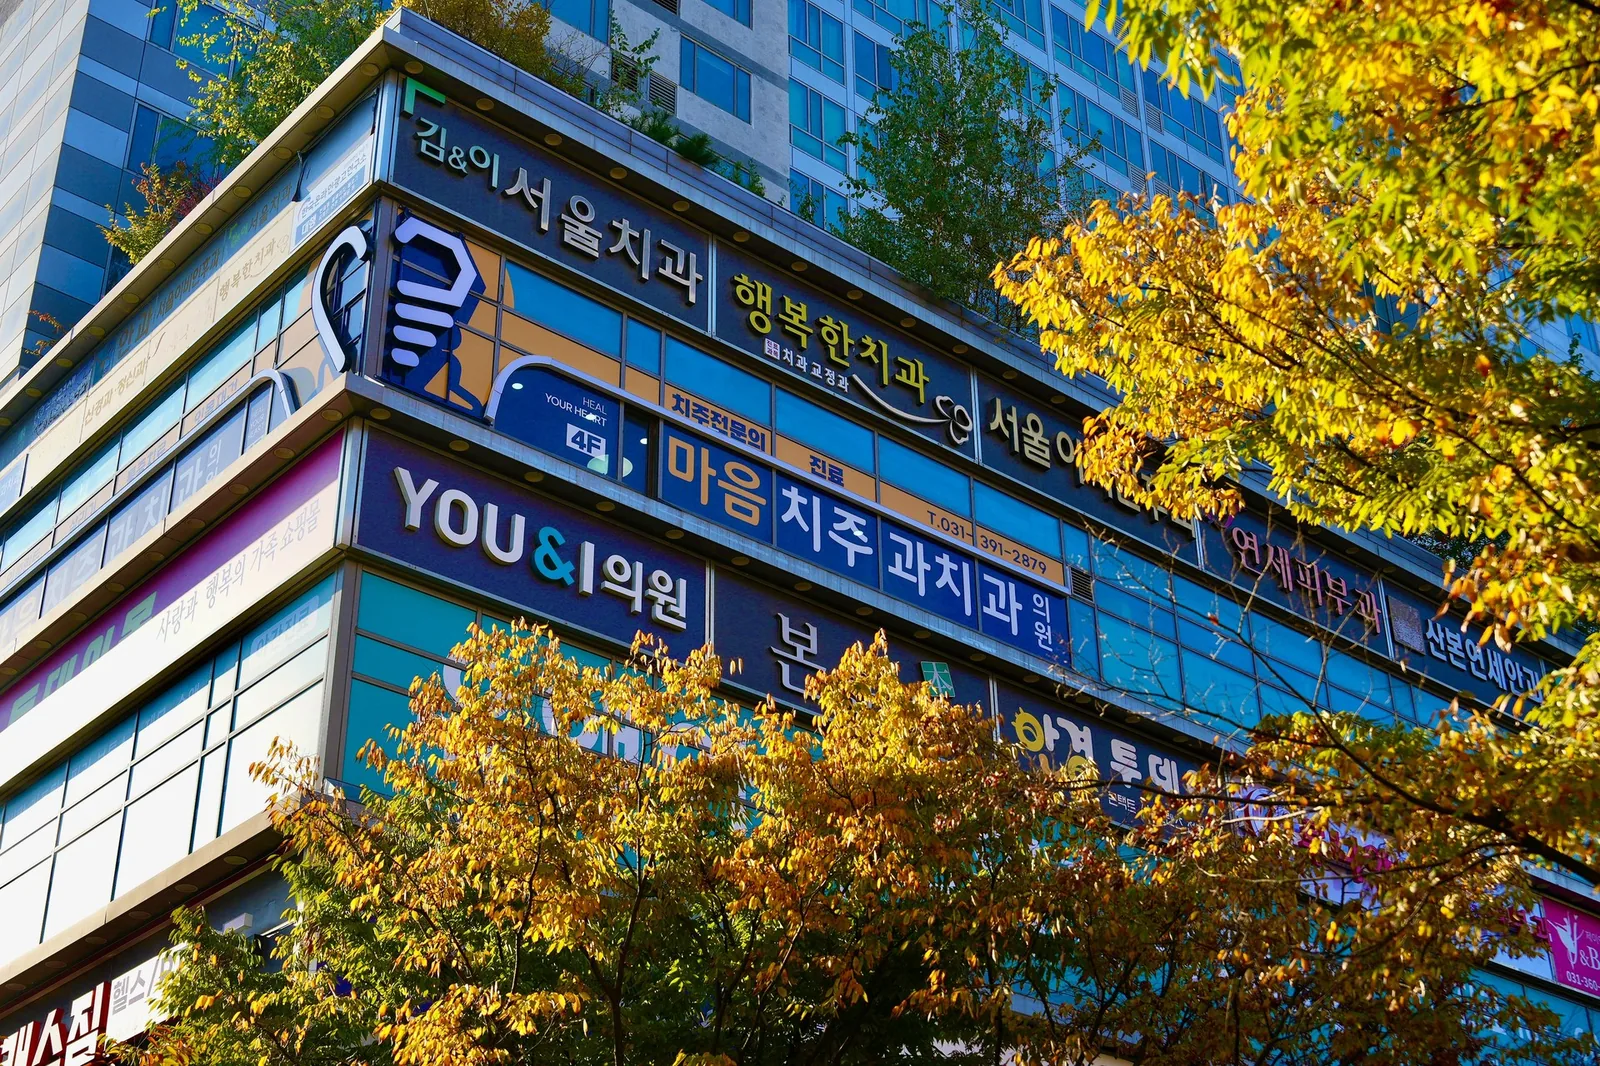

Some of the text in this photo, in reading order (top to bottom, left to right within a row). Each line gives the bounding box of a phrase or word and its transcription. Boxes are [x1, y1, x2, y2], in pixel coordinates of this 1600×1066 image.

[733, 273, 930, 405] 행복한치과
[545, 392, 573, 413] YOUR
[582, 396, 607, 416] HEAL
[570, 429, 602, 455] 4F
[809, 454, 845, 488] 진료
[1231, 526, 1381, 634] 연세피부과
[156, 590, 198, 643] 사랑과
[206, 553, 246, 610] 행복의
